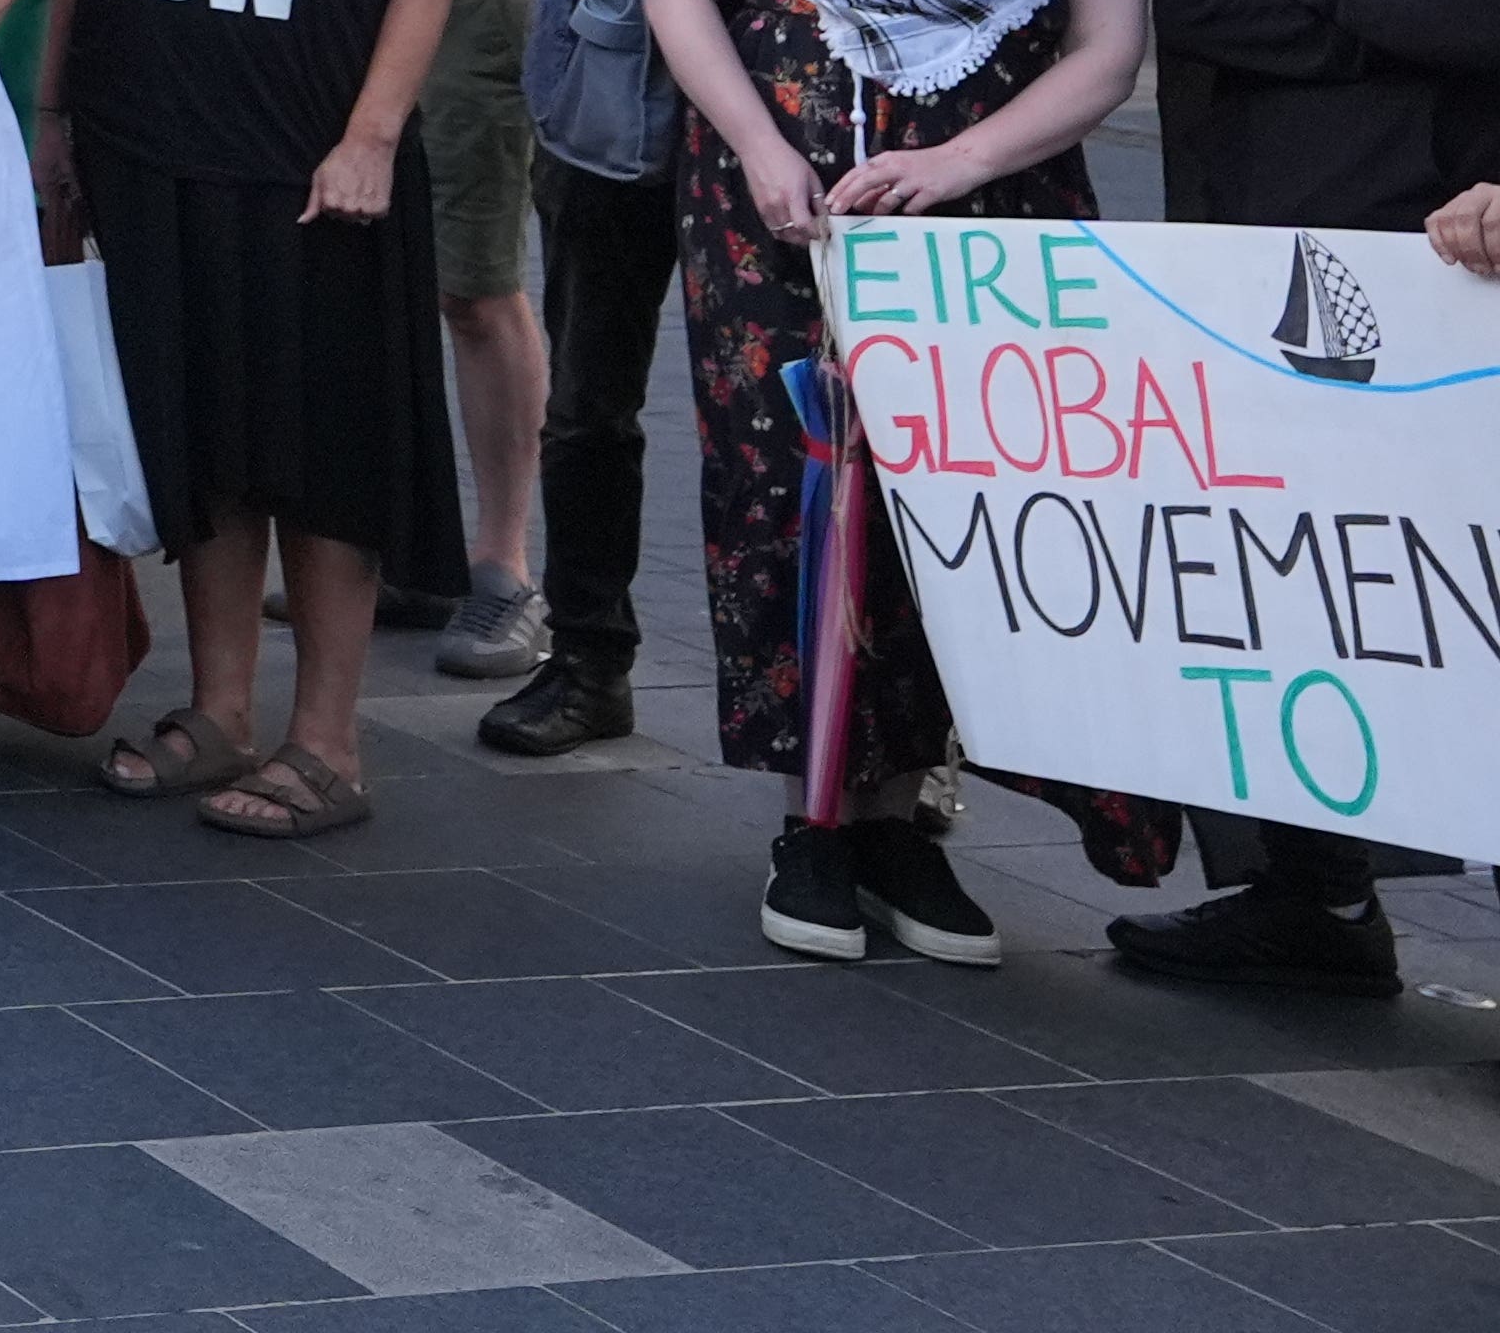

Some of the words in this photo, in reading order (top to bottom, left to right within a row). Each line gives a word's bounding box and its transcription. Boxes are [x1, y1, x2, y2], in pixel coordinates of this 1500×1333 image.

[847, 334, 1286, 492] GLOBAL
[891, 489, 1500, 669] MOVEMEN
[1180, 666, 1379, 817] TO
